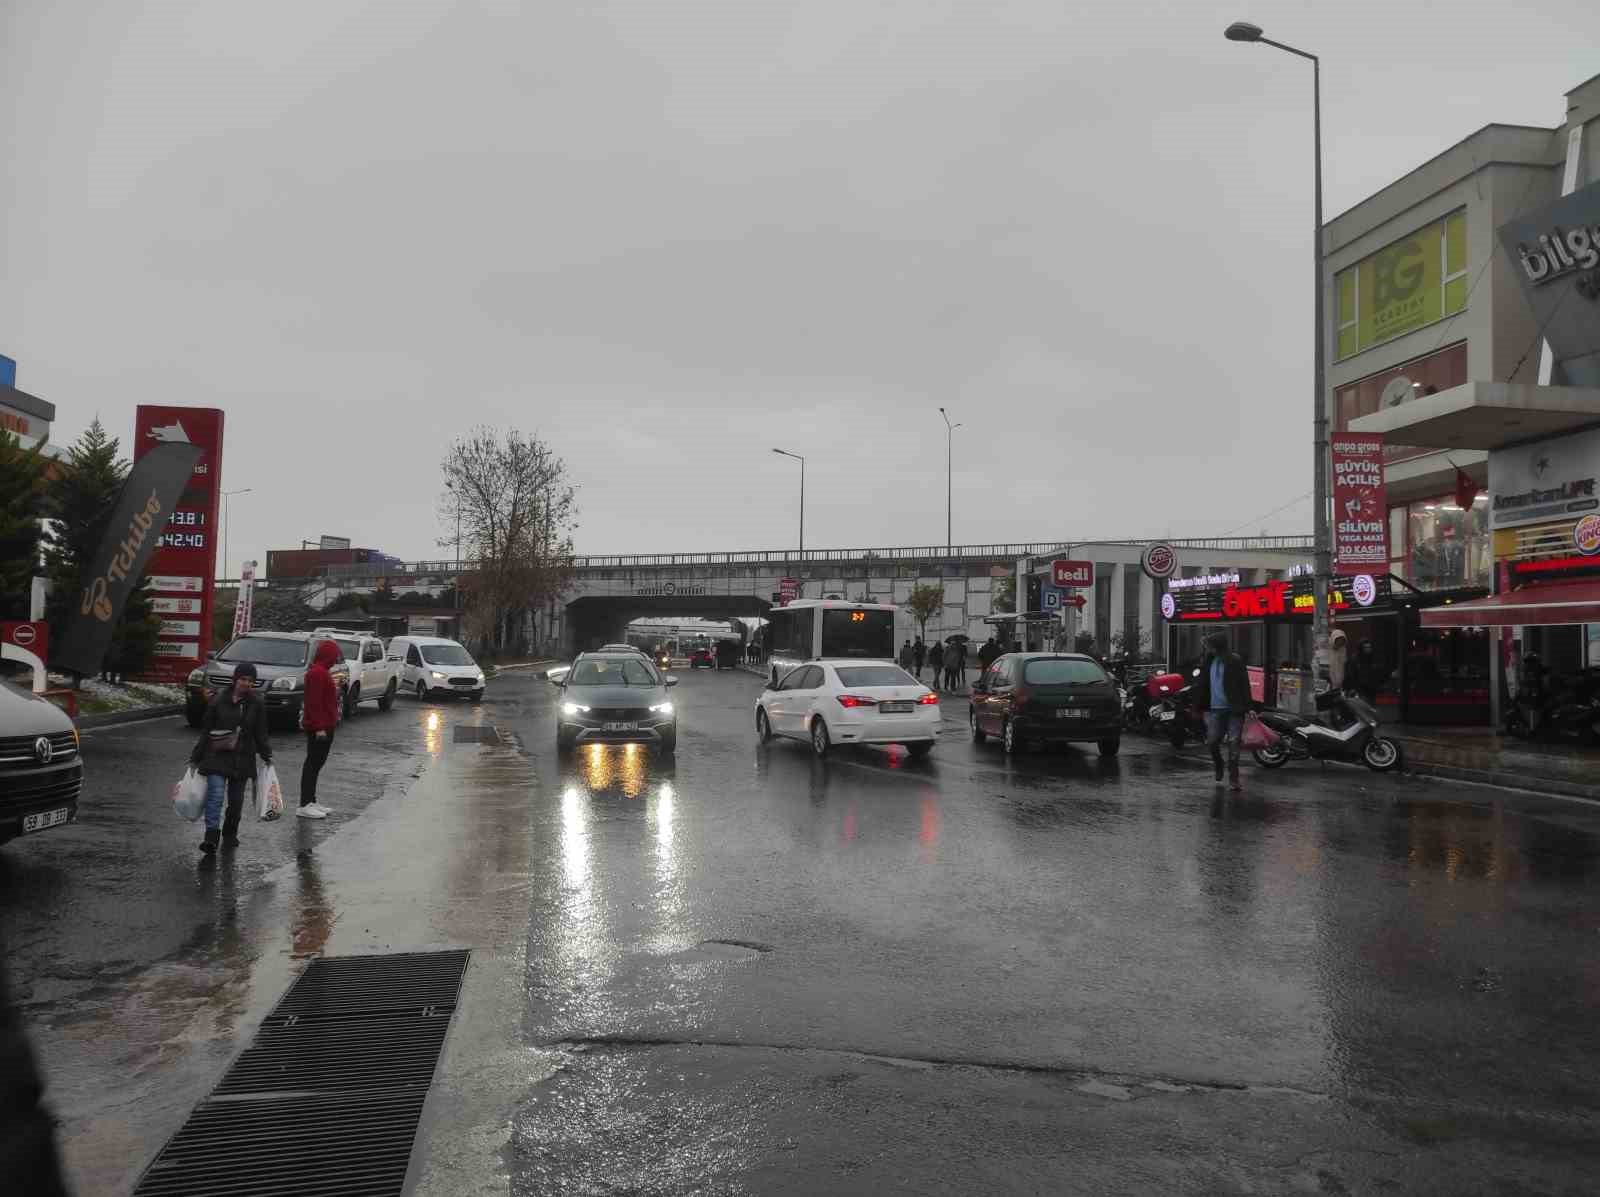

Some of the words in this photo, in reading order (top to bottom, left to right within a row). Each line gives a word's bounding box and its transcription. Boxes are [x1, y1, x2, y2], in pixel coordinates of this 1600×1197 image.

[1335, 459, 1380, 473] BÜYÜK
[1337, 474, 1381, 488] AÇILIŞ
[1338, 519, 1383, 533] SİLİVRİ
